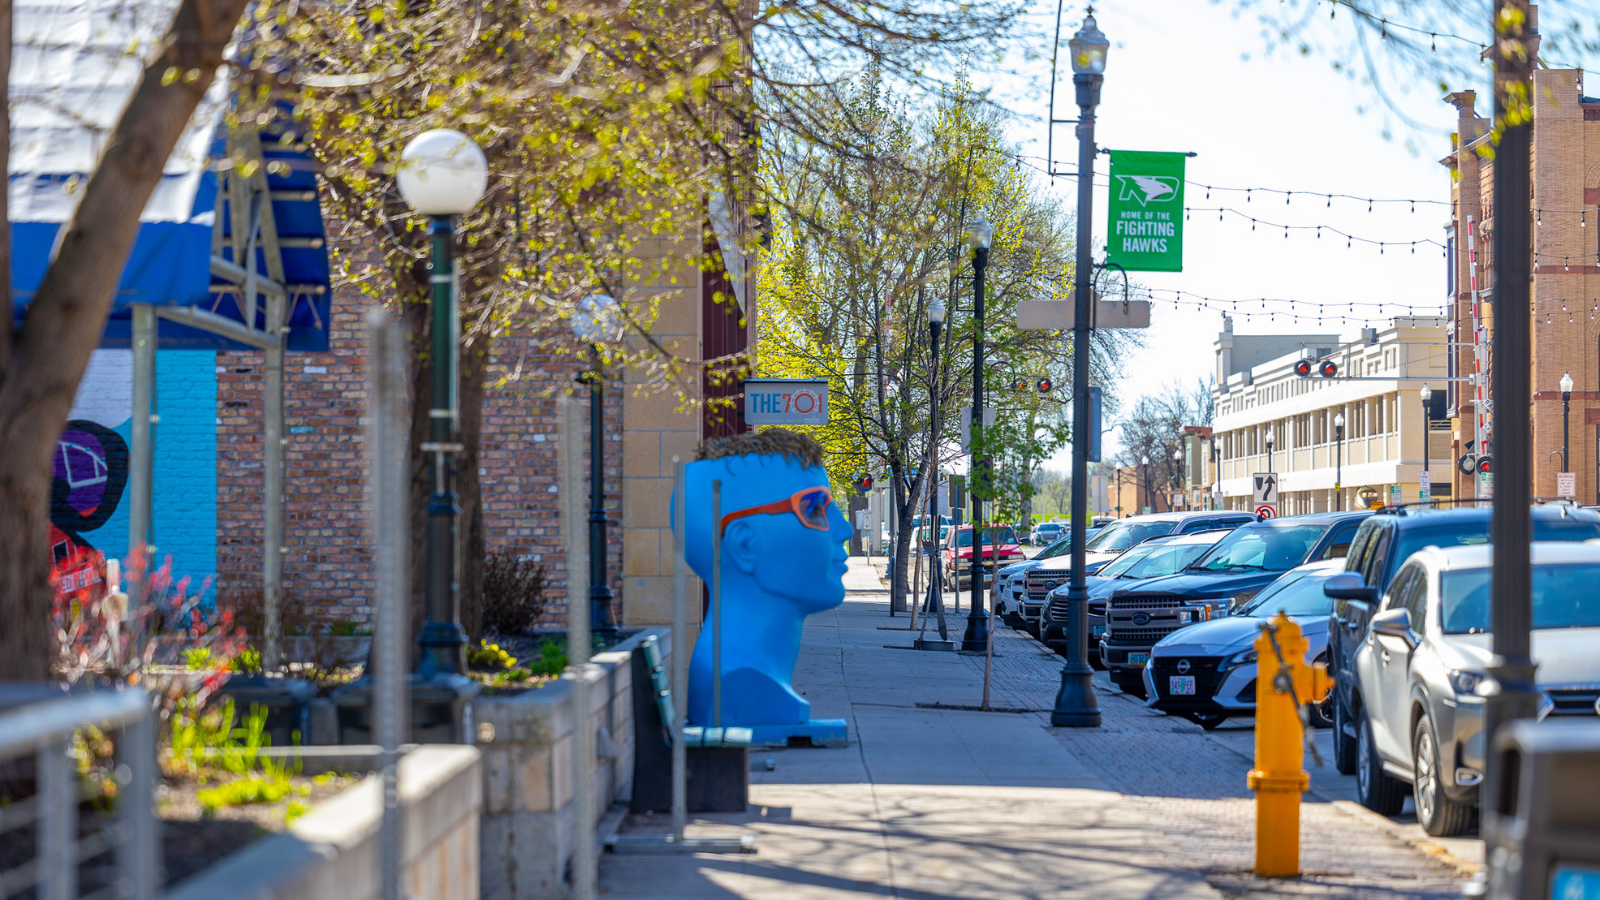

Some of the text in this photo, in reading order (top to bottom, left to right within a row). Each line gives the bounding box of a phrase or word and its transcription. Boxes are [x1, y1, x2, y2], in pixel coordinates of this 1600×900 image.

[1121, 211, 1171, 220] HOME OF THE
[1116, 220, 1175, 237] FIGHTING
[1122, 237, 1168, 253] HAWKS
